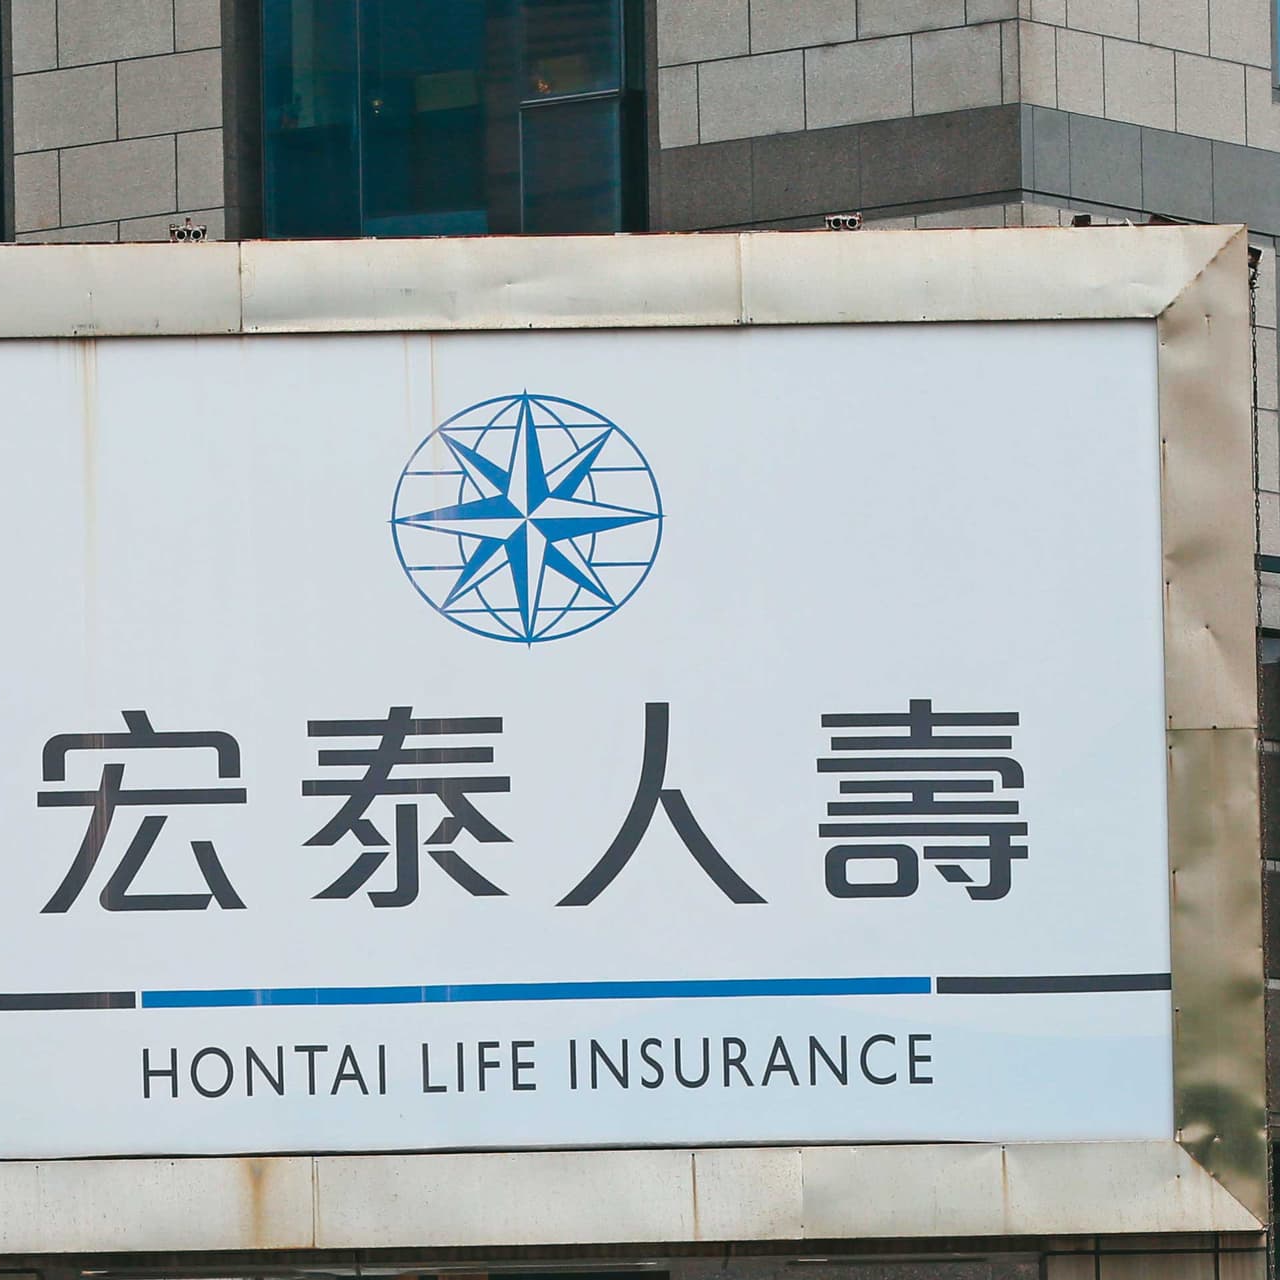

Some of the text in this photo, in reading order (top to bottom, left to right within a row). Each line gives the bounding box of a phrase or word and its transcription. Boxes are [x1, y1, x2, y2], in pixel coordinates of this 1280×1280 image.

[37, 699, 1029, 914] 宏泰人壽
[143, 1033, 934, 1099] HONTAI LIFE INSURANCE
